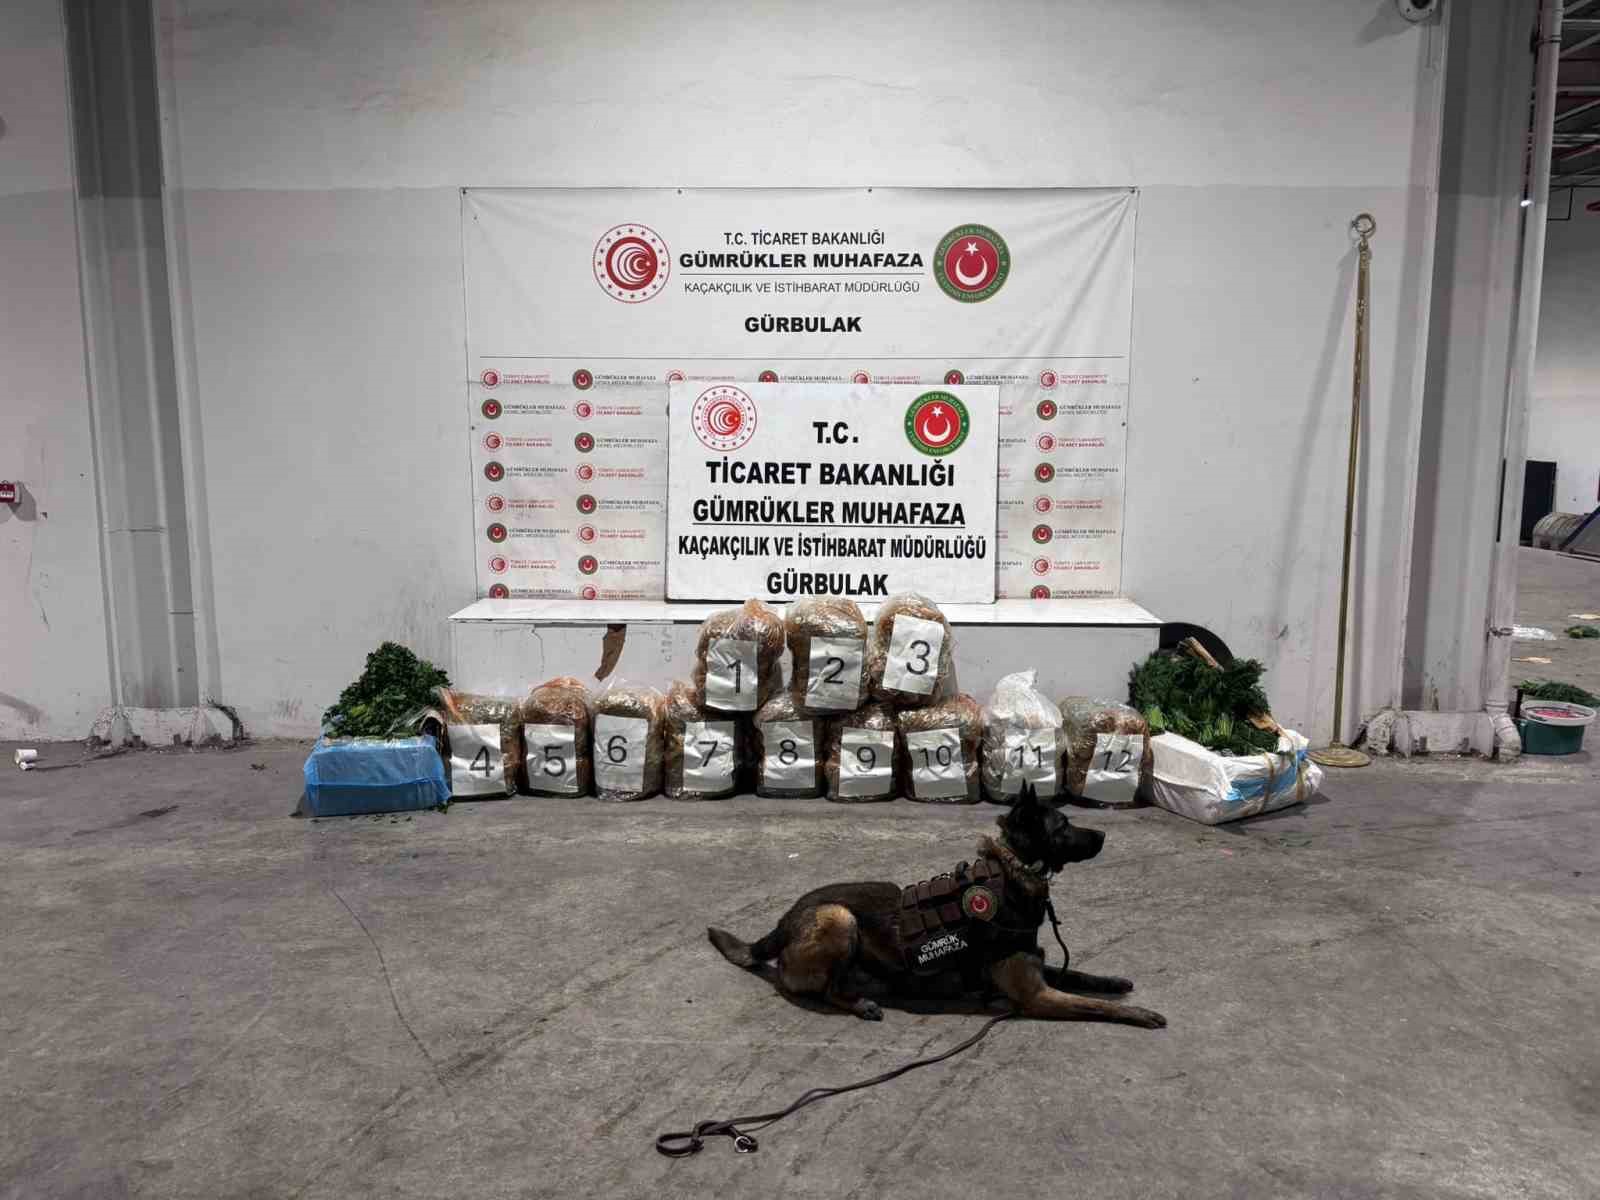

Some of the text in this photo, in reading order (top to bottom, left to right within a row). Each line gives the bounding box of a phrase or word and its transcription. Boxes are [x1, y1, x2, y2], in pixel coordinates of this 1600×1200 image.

[723, 229, 885, 245] T.C. TİCARET BAKANLIĞI
[679, 250, 924, 268] GÜMRÜKLER MUHAFAZA
[684, 279, 920, 296] KAÇAKÇILIK VE İSTİHBARAT MÜDÜRLÜĞÜ
[744, 313, 862, 333] GÜRBULAK
[812, 421, 859, 445] T.C.
[705, 456, 955, 487] TİCARET BAKANLIĞI
[693, 495, 966, 525] GÜMRÜKLER MUHAFAZA
[678, 532, 986, 561] KAÇAKÇILIK VE İSTİHBARAT MÜDÜRLÜĞÜ
[766, 567, 889, 596] GÜRBULAK
[823, 656, 848, 685] 2
[906, 639, 931, 675] 3
[727, 658, 742, 693] 1
[470, 744, 495, 778] 4
[543, 744, 568, 778] 5
[606, 735, 628, 764] 6
[697, 740, 719, 768] 7
[778, 739, 801, 765] 8
[856, 746, 876, 772] 9
[919, 745, 951, 767] 10
[1014, 745, 1041, 769] 11
[1103, 749, 1131, 772] 12
[920, 933, 960, 953] GÜMRÜK
